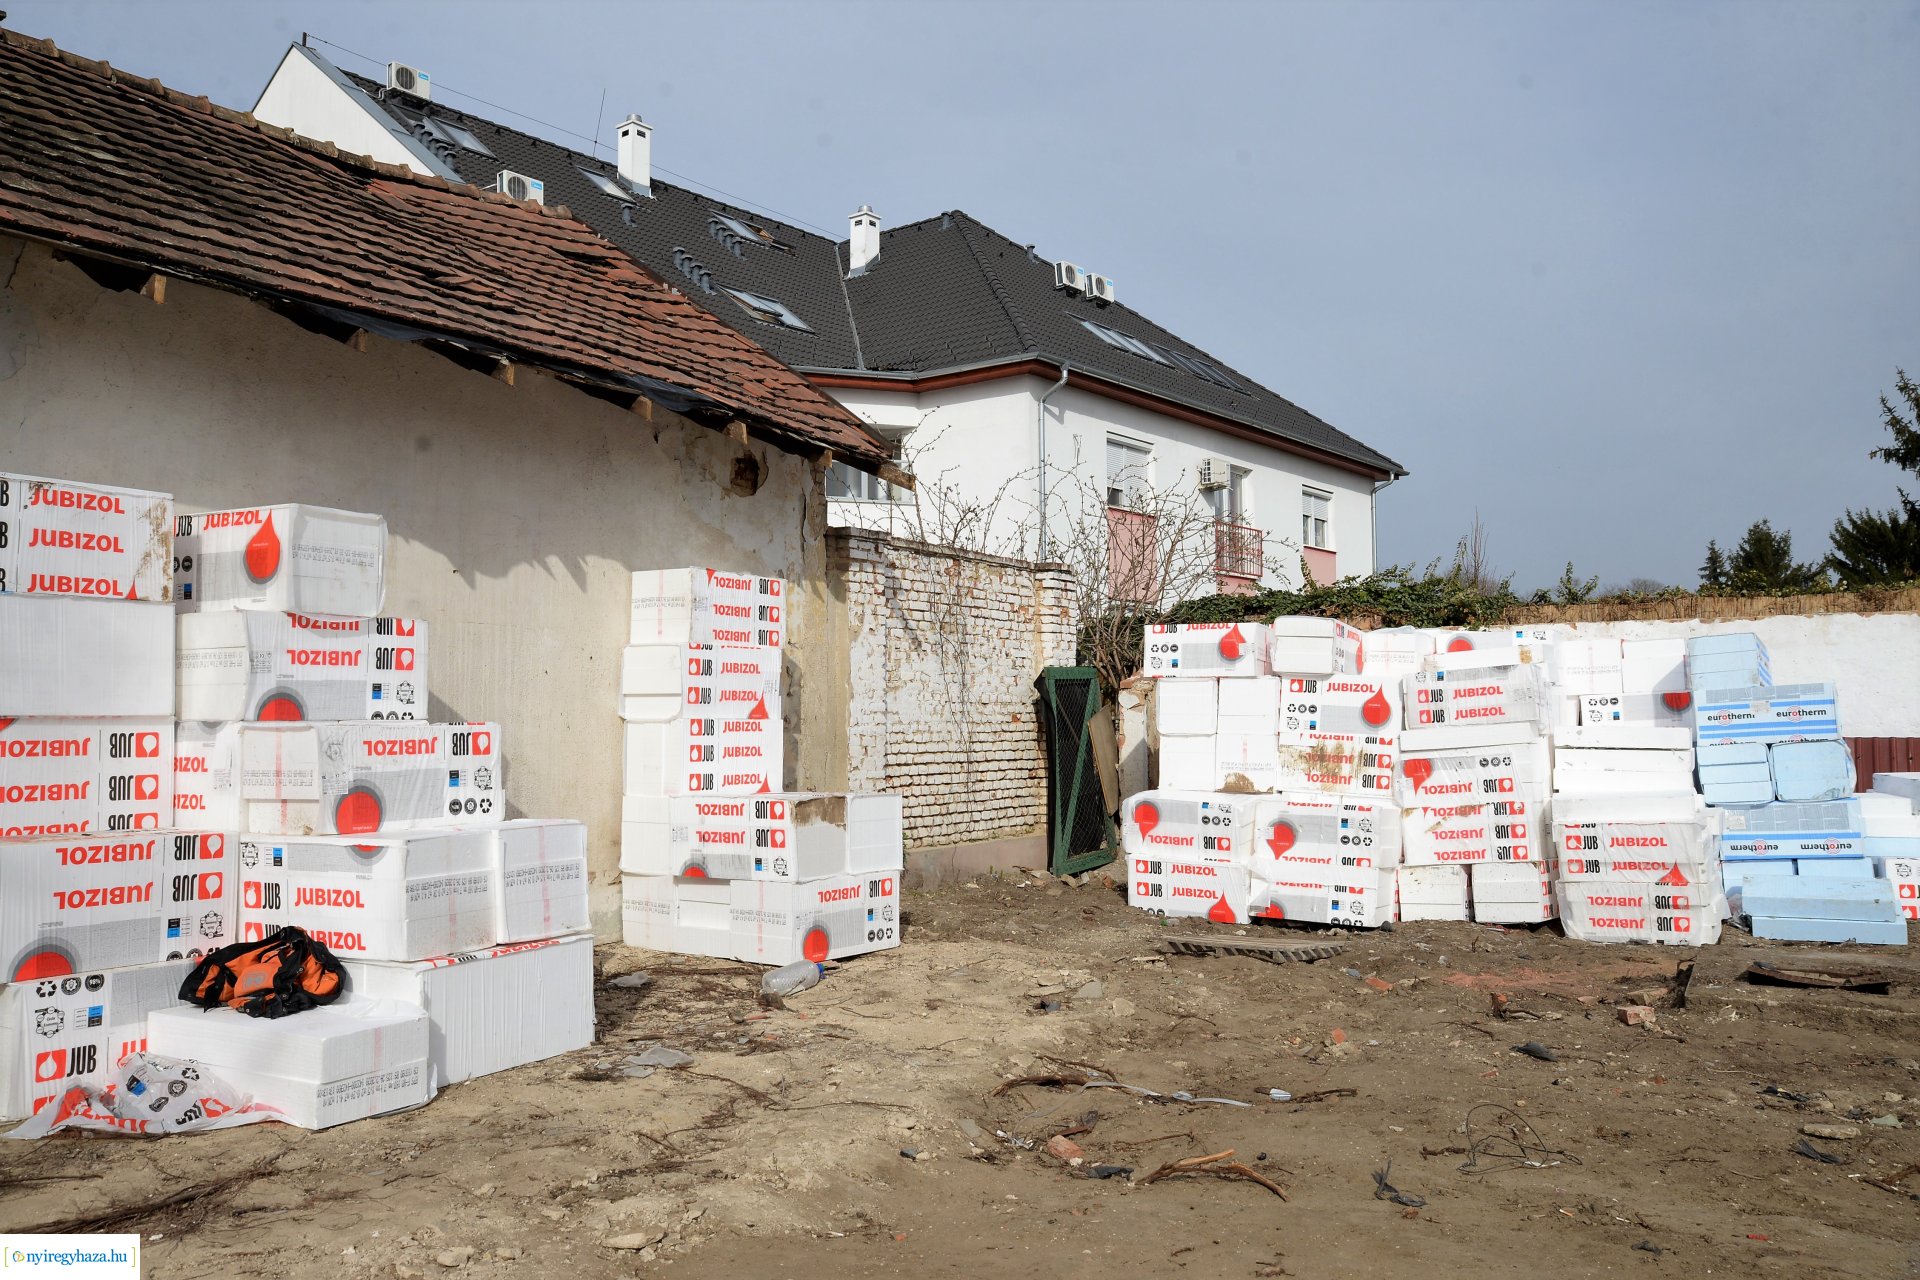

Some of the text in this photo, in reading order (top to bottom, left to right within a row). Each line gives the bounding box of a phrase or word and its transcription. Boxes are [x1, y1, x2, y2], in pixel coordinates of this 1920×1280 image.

[31, 487, 125, 514] JUBIZOL
[176, 509, 262, 537] JUB JUBIZOL
[29, 528, 124, 553] JUBIZOL
[27, 573, 123, 596] JUBIZOL
[714, 576, 770, 595] JUB JUBIZOL
[713, 604, 769, 621] JUB JUBIZOL
[712, 629, 769, 645] JUB JUBIZOL
[287, 649, 361, 666] JUBIZOL
[376, 647, 395, 670] JUB
[701, 659, 761, 676] JUB JUBIZOL
[1304, 678, 1376, 694] JUB JUBIZOL
[1430, 686, 1504, 703] JUB JUBIZOL
[700, 688, 759, 704] JUB JUBIZOL
[1432, 706, 1506, 724] JUB JUBIZOL
[1776, 708, 1827, 718] eurotherm
[702, 720, 763, 736] JUB JUBIZOL
[110, 733, 135, 758] JUB
[363, 732, 471, 757] JUB JUBIZOL
[702, 745, 762, 762] JUB JUBIZOL
[1364, 754, 1377, 768] JUB
[109, 775, 134, 801] JUB
[702, 774, 762, 791] JUB JUBIZOL
[1306, 772, 1376, 789] JUB JUBIZOL
[1422, 778, 1498, 795] JUB JUBIZOL
[696, 801, 769, 819] JUB JUBIZOL
[696, 828, 770, 848] JUB JUBIZOL
[1432, 824, 1509, 841] JUB JUBIZOL
[56, 834, 199, 866] JUB JUBIZOL
[1148, 834, 1217, 850] JUB JUBIZOL
[1583, 836, 1668, 850] JUB JUBIZOL
[1730, 844, 1778, 852] eurotherm
[1434, 846, 1511, 861] JUB JUBIZOL
[1149, 861, 1217, 877] JUB JUBIZOL
[1585, 860, 1670, 874] JUB JUBIZOL
[53, 874, 198, 910] JUB JUBIZOL
[262, 882, 365, 910] JUB JUBIZOL
[818, 880, 881, 903] JUB JUBIZOL
[1150, 884, 1219, 900] JUB JUBIZOL
[1587, 896, 1671, 910] JUB JUBIZOL
[1589, 917, 1673, 932] JUB JUBIZOL
[67, 1044, 97, 1077] JUB
